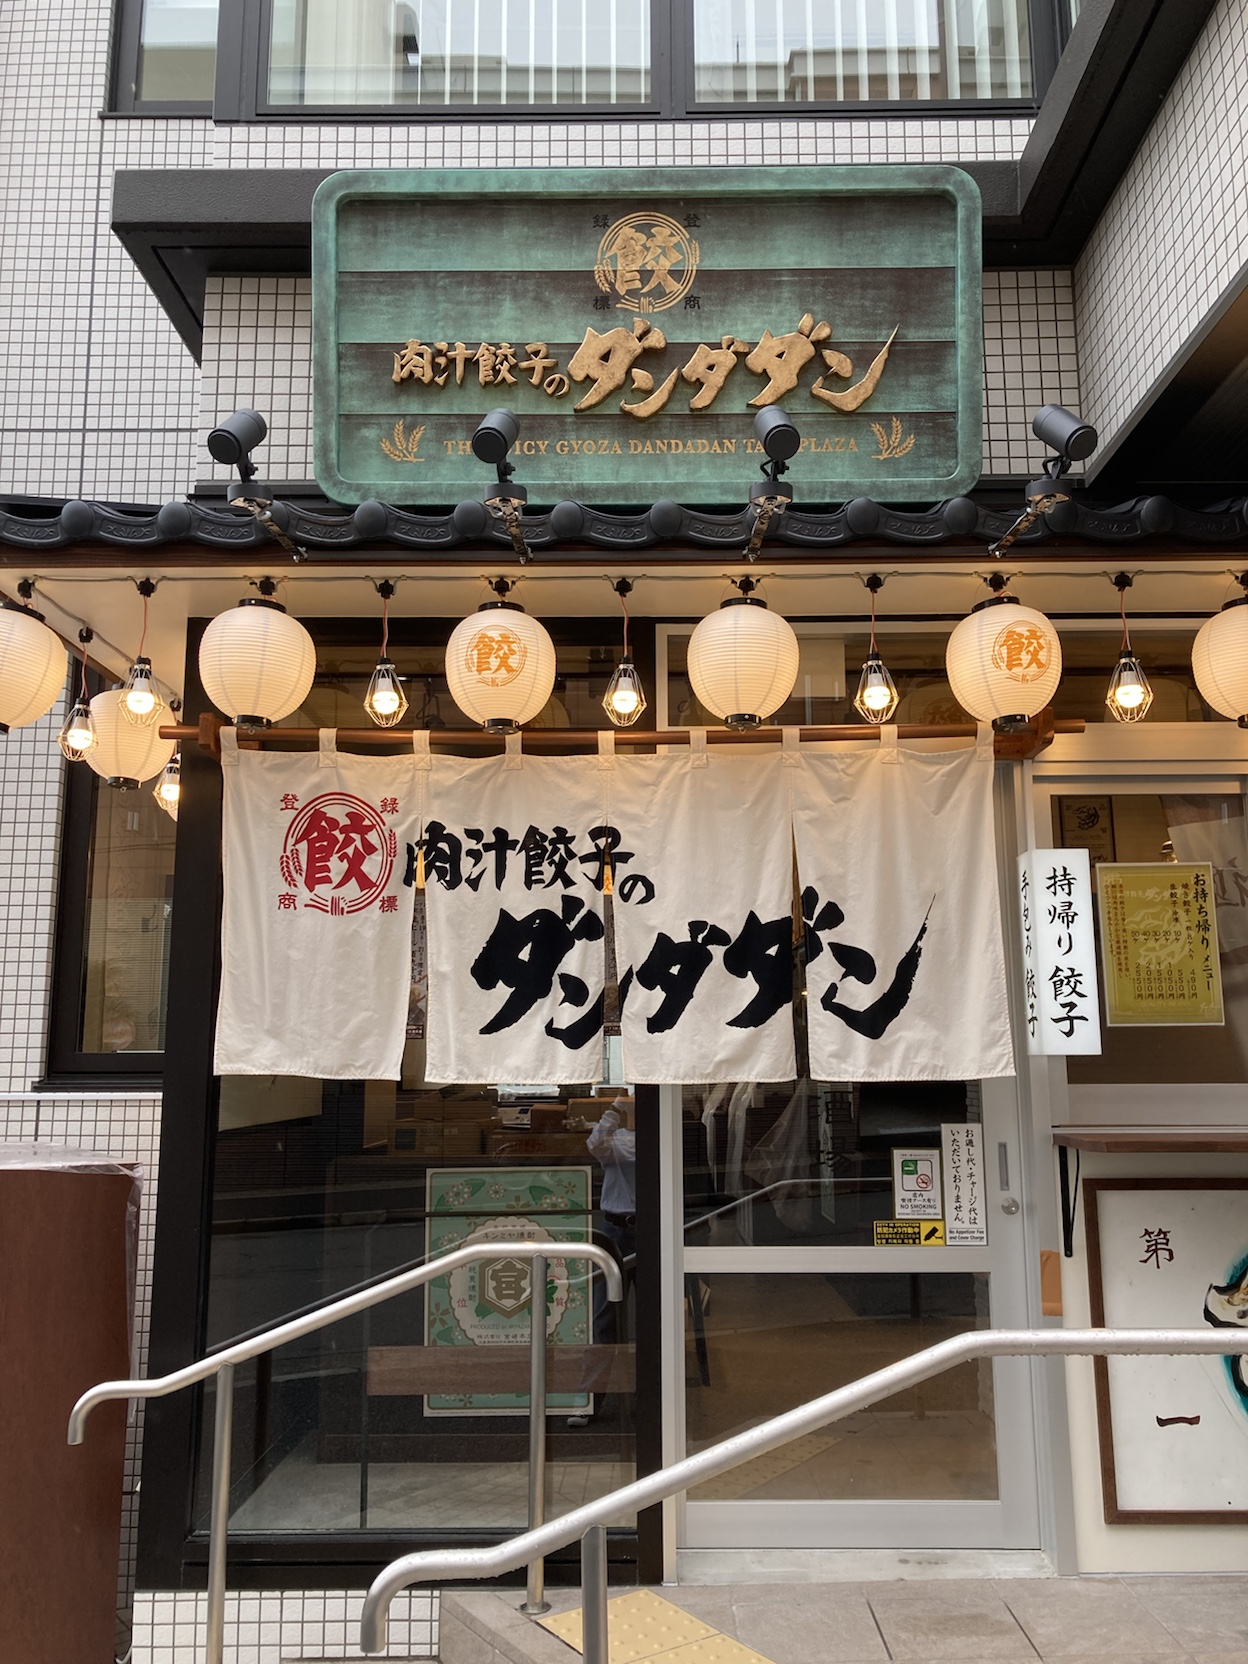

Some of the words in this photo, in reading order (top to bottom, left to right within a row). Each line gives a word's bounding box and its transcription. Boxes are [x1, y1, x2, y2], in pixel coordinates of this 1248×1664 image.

[683, 213, 701, 228] 登
[604, 225, 683, 296] 餃
[683, 294, 701, 310] 商
[392, 338, 571, 398] 肉汁餃子の
[567, 313, 900, 420] ダンダダン
[443, 440, 473, 455] TH
[555, 440, 623, 455] GYOZA
[628, 438, 736, 455] DANDADAN
[798, 437, 859, 453] PLAZA
[471, 632, 518, 676] 餃
[999, 628, 1046, 672] 餃
[280, 793, 300, 811] 登
[380, 797, 399, 815] 録
[292, 808, 379, 893] 餃
[403, 820, 656, 906] 肉汁餃子の
[278, 892, 298, 911] 商
[379, 895, 398, 913] 標
[1046, 866, 1080, 957] 持帰り
[1193, 872, 1211, 950] お持ち帰り
[1203, 955, 1214, 991] メニュー
[470, 885, 937, 1050] ダンダダン
[1135, 961, 1144, 1000] 2550円
[1146, 961, 1154, 1000] 2050円
[1156, 961, 1164, 1000] 1550円
[1167, 961, 1175, 1000] 1050円
[1177, 968, 1186, 1000] 550円
[1190, 968, 1198, 1000] 490円
[1047, 965, 1090, 1039] 餃子
[950, 1128, 965, 1225] いただいておりません。
[964, 1128, 979, 1225] お通し代・チャージ代は
[1139, 1227, 1175, 1269] 第
